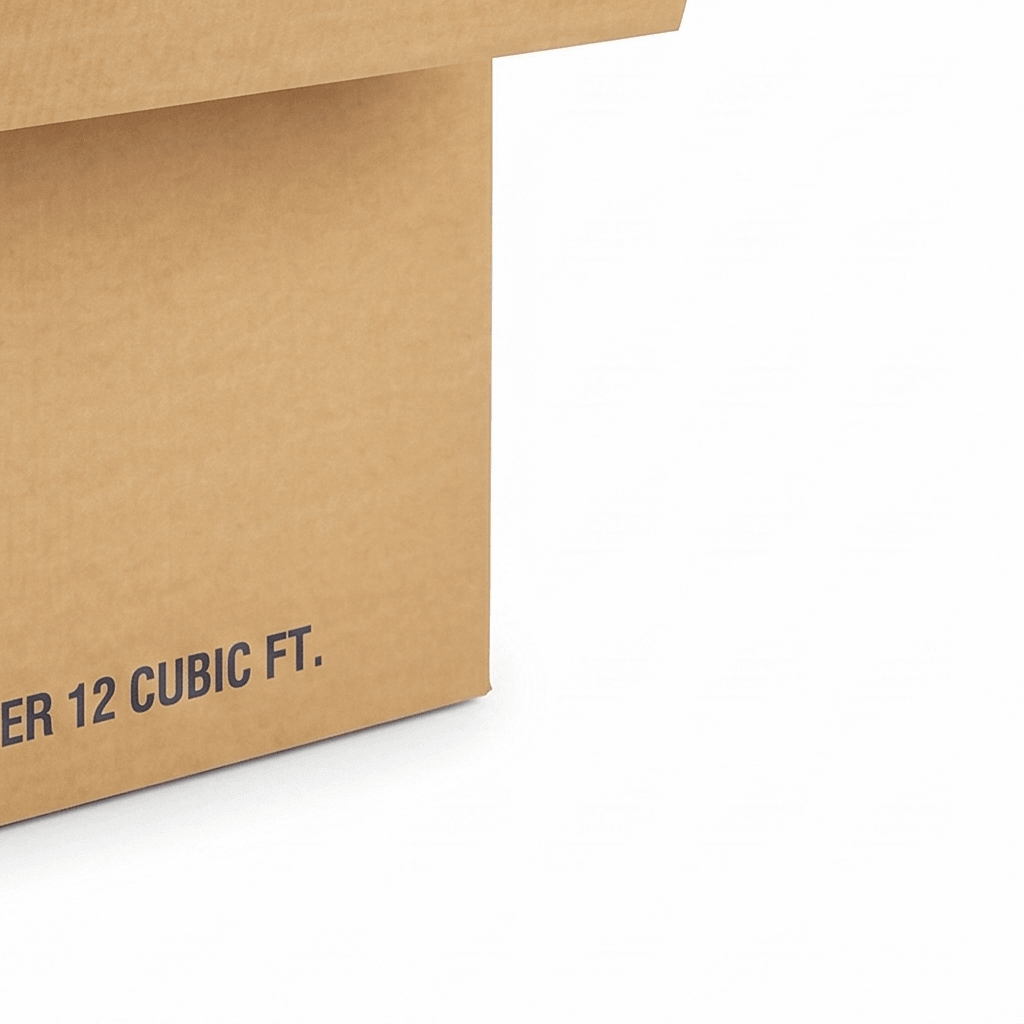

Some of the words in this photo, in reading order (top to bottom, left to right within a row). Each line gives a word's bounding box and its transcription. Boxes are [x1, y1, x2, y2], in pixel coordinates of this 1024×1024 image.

[68, 676, 116, 729] 12
[130, 641, 251, 714] CUBIC
[266, 624, 323, 680] FT.
